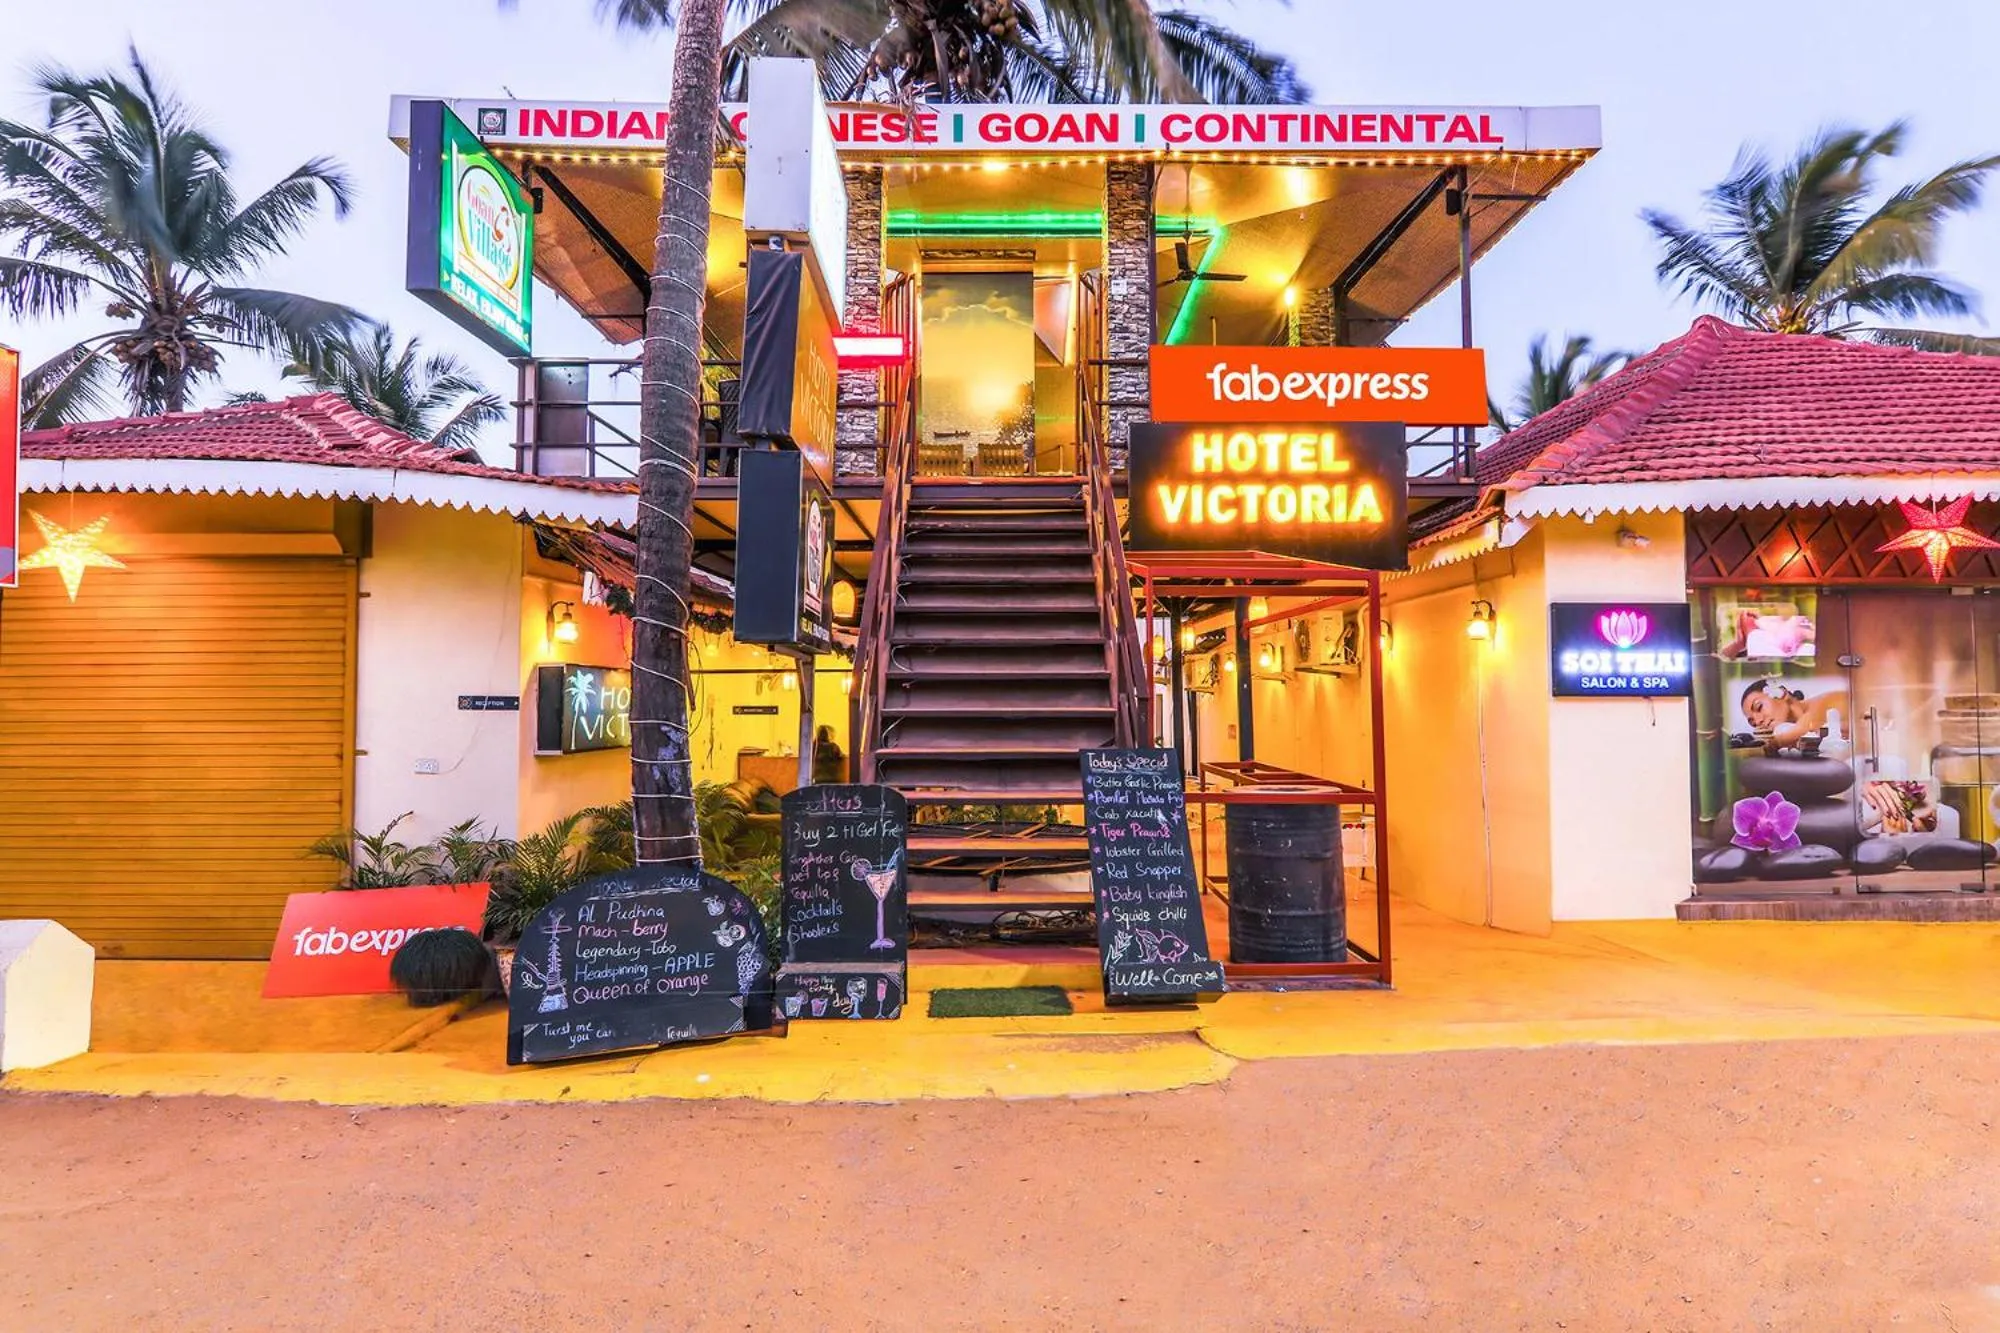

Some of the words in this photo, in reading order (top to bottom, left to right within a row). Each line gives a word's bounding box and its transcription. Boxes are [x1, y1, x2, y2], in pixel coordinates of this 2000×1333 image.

[978, 113, 1119, 143] GOAN
[1160, 113, 1504, 144] CONTINENTAL
[1206, 363, 1429, 407] fabexpress
[1190, 432, 1350, 473] HOTEL
[1158, 484, 1384, 523] VICTORIA
[1581, 677, 1627, 688] SALON
[1630, 677, 1639, 688] &
[1643, 677, 1669, 688] SPA
[580, 713, 630, 740] VICT
[827, 825, 838, 838] 2
[1106, 862, 1128, 879] Red
[1109, 885, 1142, 904] Baby
[293, 926, 464, 956] fabexpr
[632, 920, 669, 942] berry
[576, 940, 641, 964] Legendary
[665, 952, 715, 974] APPLE
[573, 983, 631, 1004] Queen
[634, 979, 650, 994] of
